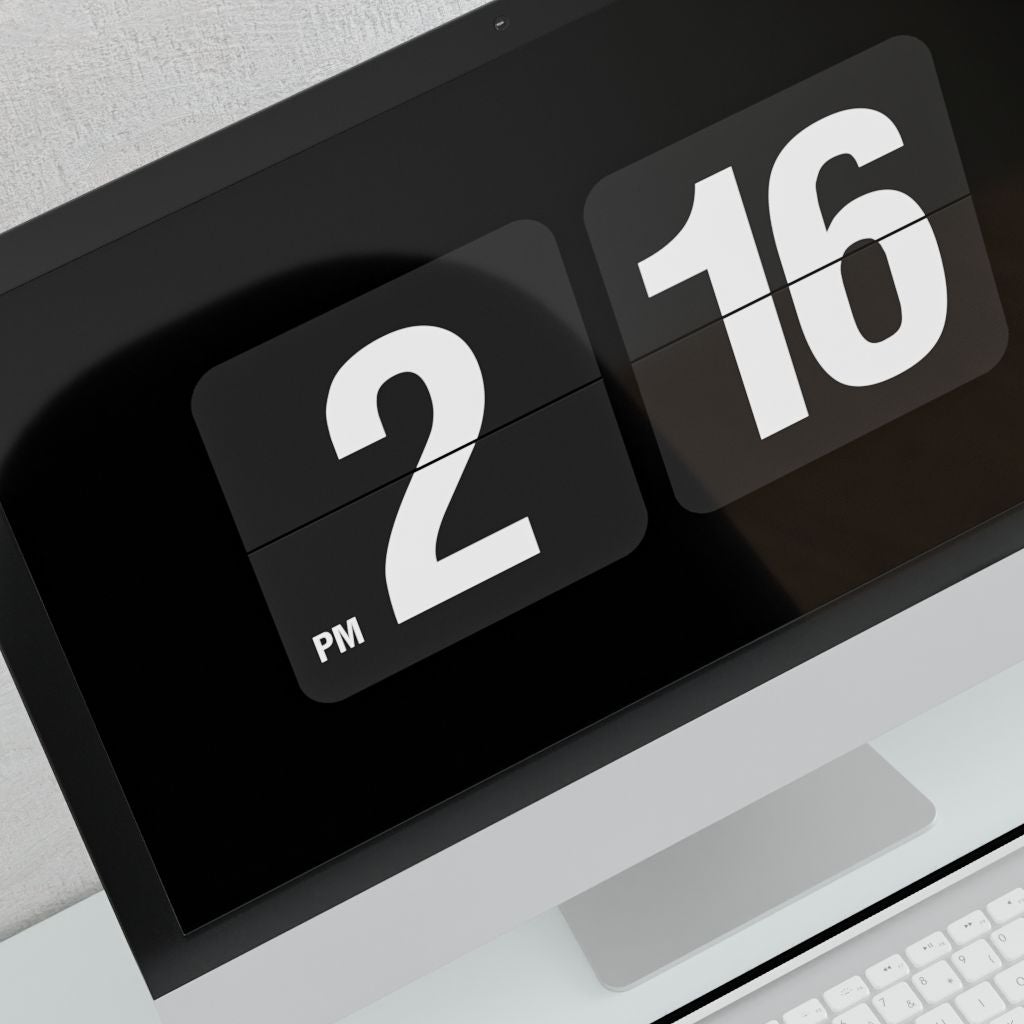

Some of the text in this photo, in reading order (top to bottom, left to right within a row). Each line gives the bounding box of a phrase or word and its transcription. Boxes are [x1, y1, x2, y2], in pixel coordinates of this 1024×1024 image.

[326, 108, 947, 624] 2 16
[313, 617, 365, 663] PM
[958, 955, 967, 964] 9
[918, 976, 928, 986] 8
[878, 997, 886, 1007] 7
